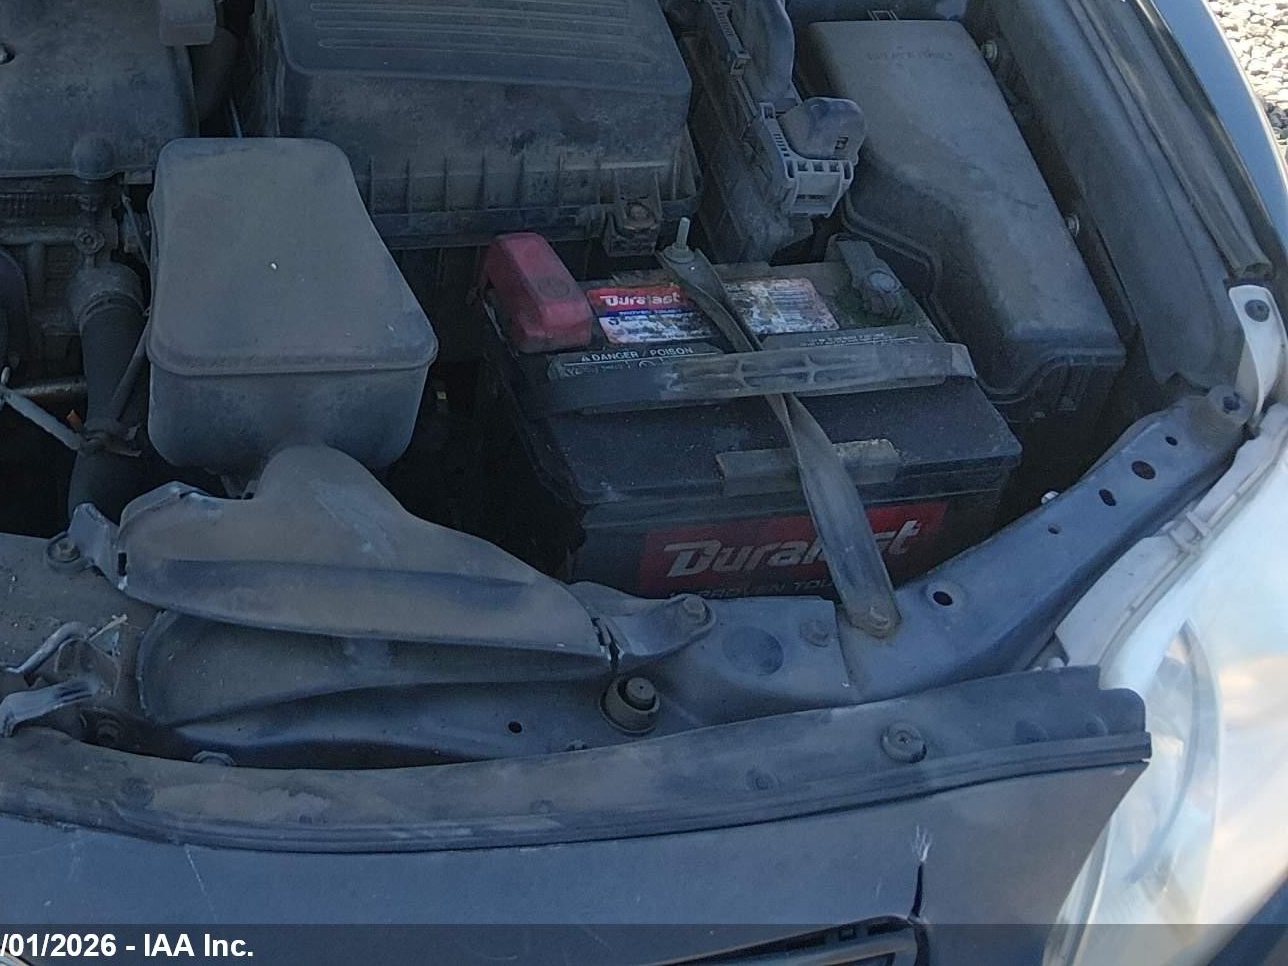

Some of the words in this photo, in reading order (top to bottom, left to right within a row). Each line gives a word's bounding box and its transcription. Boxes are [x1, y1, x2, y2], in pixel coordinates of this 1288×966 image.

[599, 292, 681, 307] Duralast
[591, 351, 639, 362] DANGER
[649, 346, 694, 358] POISON
[663, 520, 918, 578] Duralst
